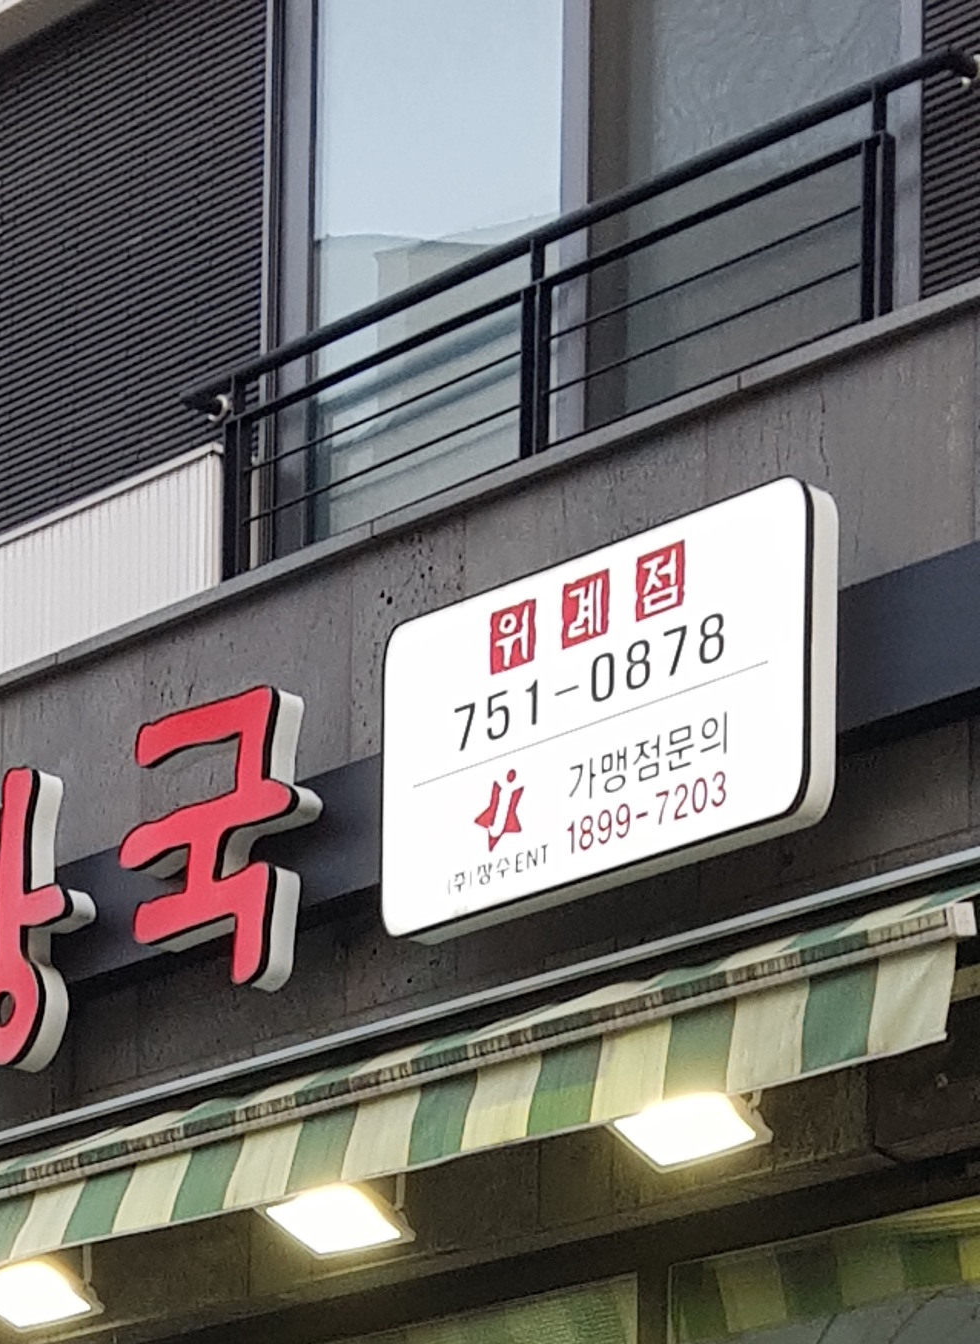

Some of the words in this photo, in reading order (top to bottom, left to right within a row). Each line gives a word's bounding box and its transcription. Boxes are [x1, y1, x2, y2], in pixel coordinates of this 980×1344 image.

[453, 612, 726, 752] 751-0878
[568, 711, 729, 801] 가맹점문의
[565, 770, 728, 855] 1899-7203
